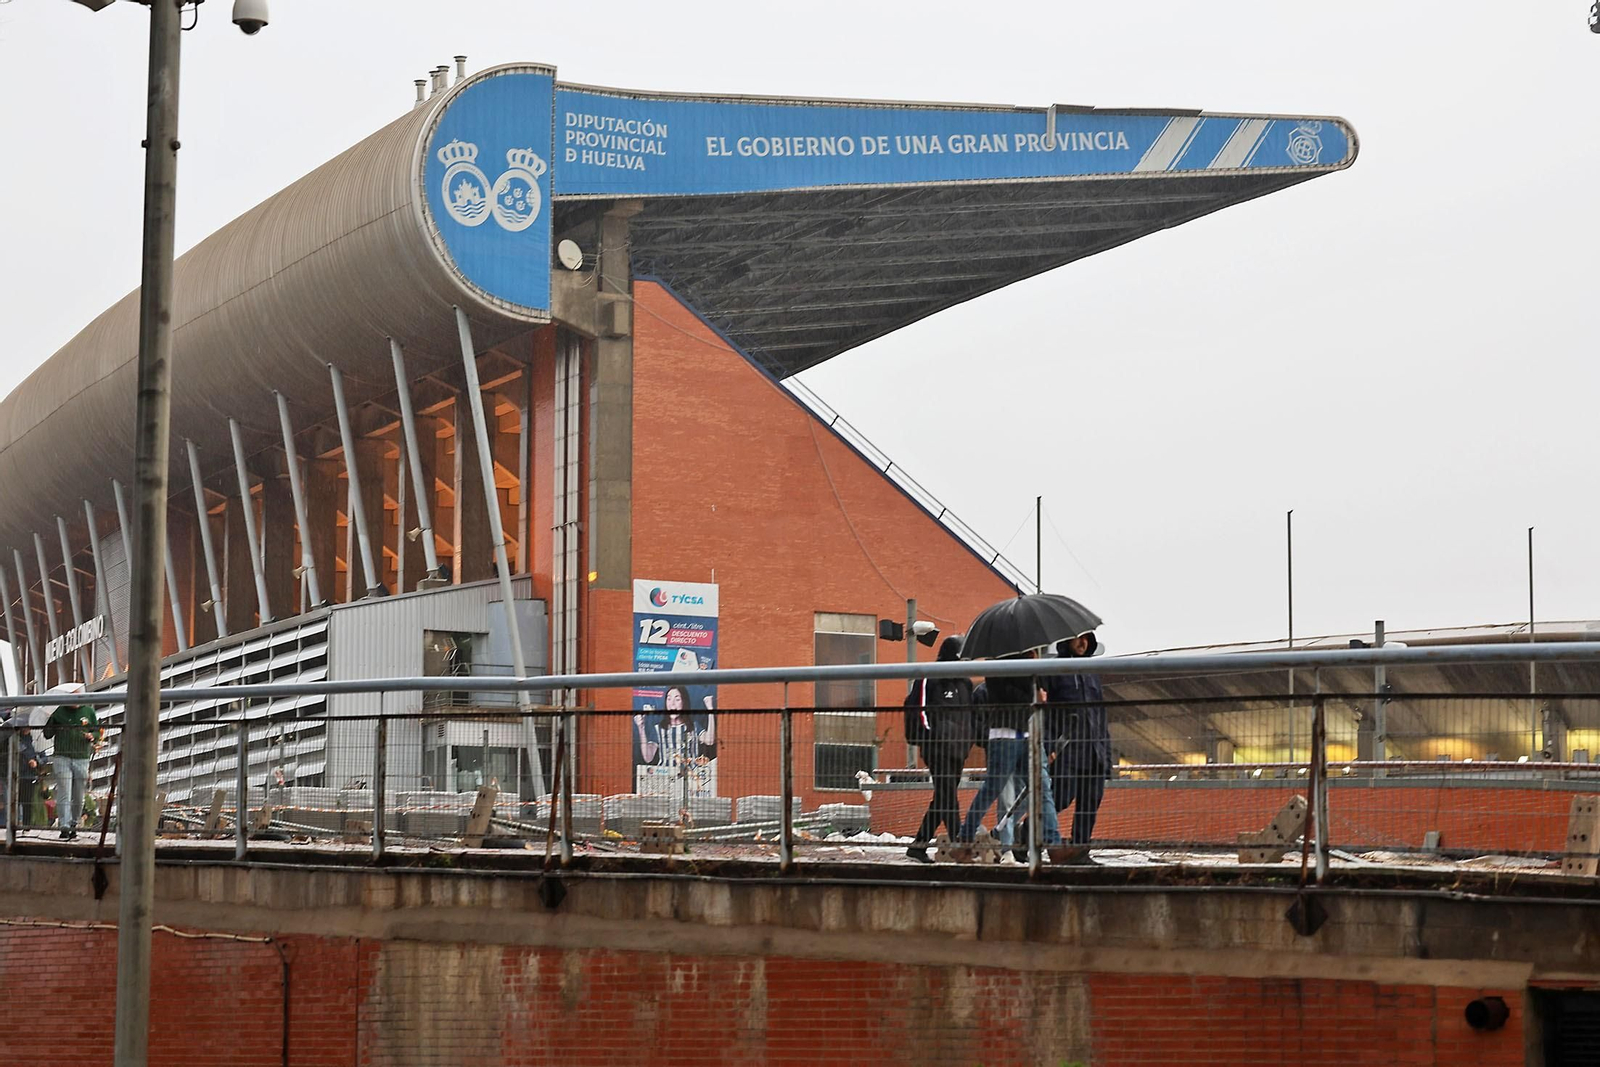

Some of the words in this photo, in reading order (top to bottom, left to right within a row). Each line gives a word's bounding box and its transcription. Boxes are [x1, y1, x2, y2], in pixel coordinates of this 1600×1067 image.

[565, 112, 668, 139] DIPUTACIÓN
[565, 130, 667, 156] PROVINCIAL
[705, 136, 733, 157] EL
[736, 136, 855, 157] GOBIERNO
[860, 135, 891, 155] DE
[895, 134, 944, 154] UNA
[947, 133, 1008, 154] GRAN
[1014, 131, 1130, 153] PROVINCIA
[581, 149, 646, 171] HUELVA
[671, 594, 704, 605] TYCSA
[639, 618, 670, 645] 12
[671, 630, 708, 638] DESCUENTO
